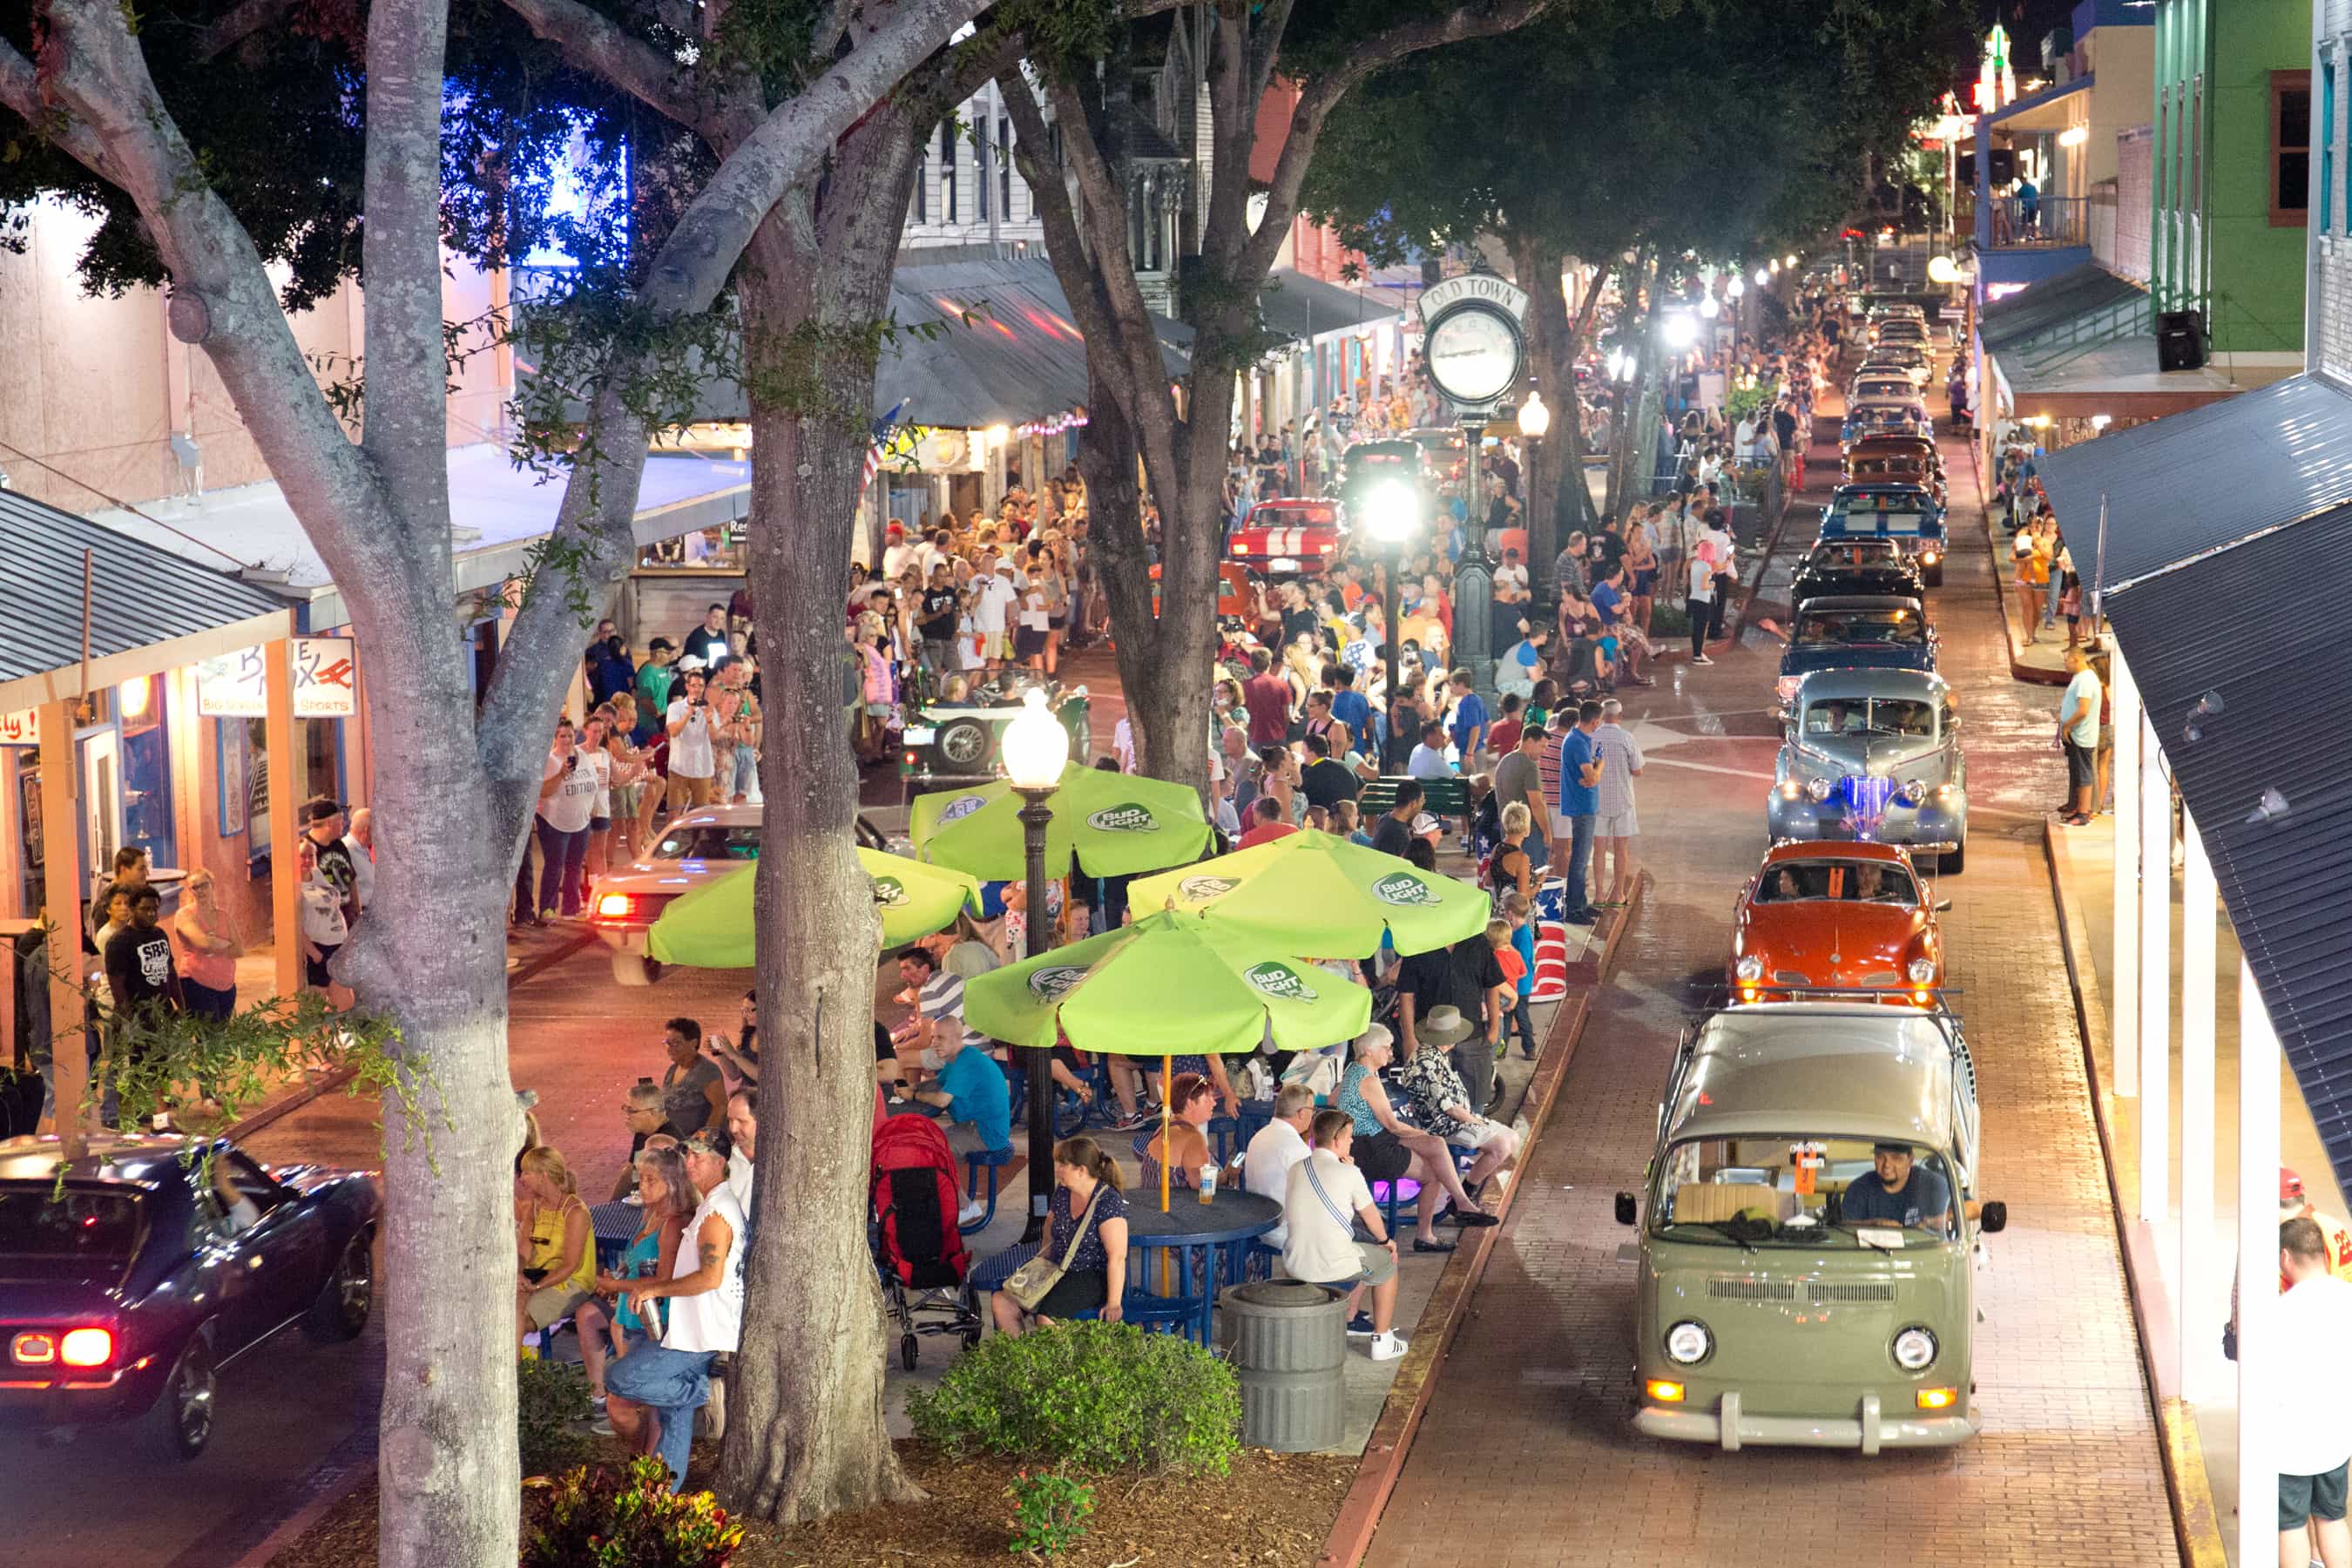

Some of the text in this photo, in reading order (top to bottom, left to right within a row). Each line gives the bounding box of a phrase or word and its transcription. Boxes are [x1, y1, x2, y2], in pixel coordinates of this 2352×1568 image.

[300, 699, 349, 712] SPORTS
[1099, 813, 1150, 827] LIGHT
[1102, 808, 1141, 821] BUD
[1380, 878, 1414, 894] BUD
[1383, 882, 1425, 901] LIGHT
[1252, 970, 1287, 983] BUD
[1257, 975, 1299, 992] LIGHT
